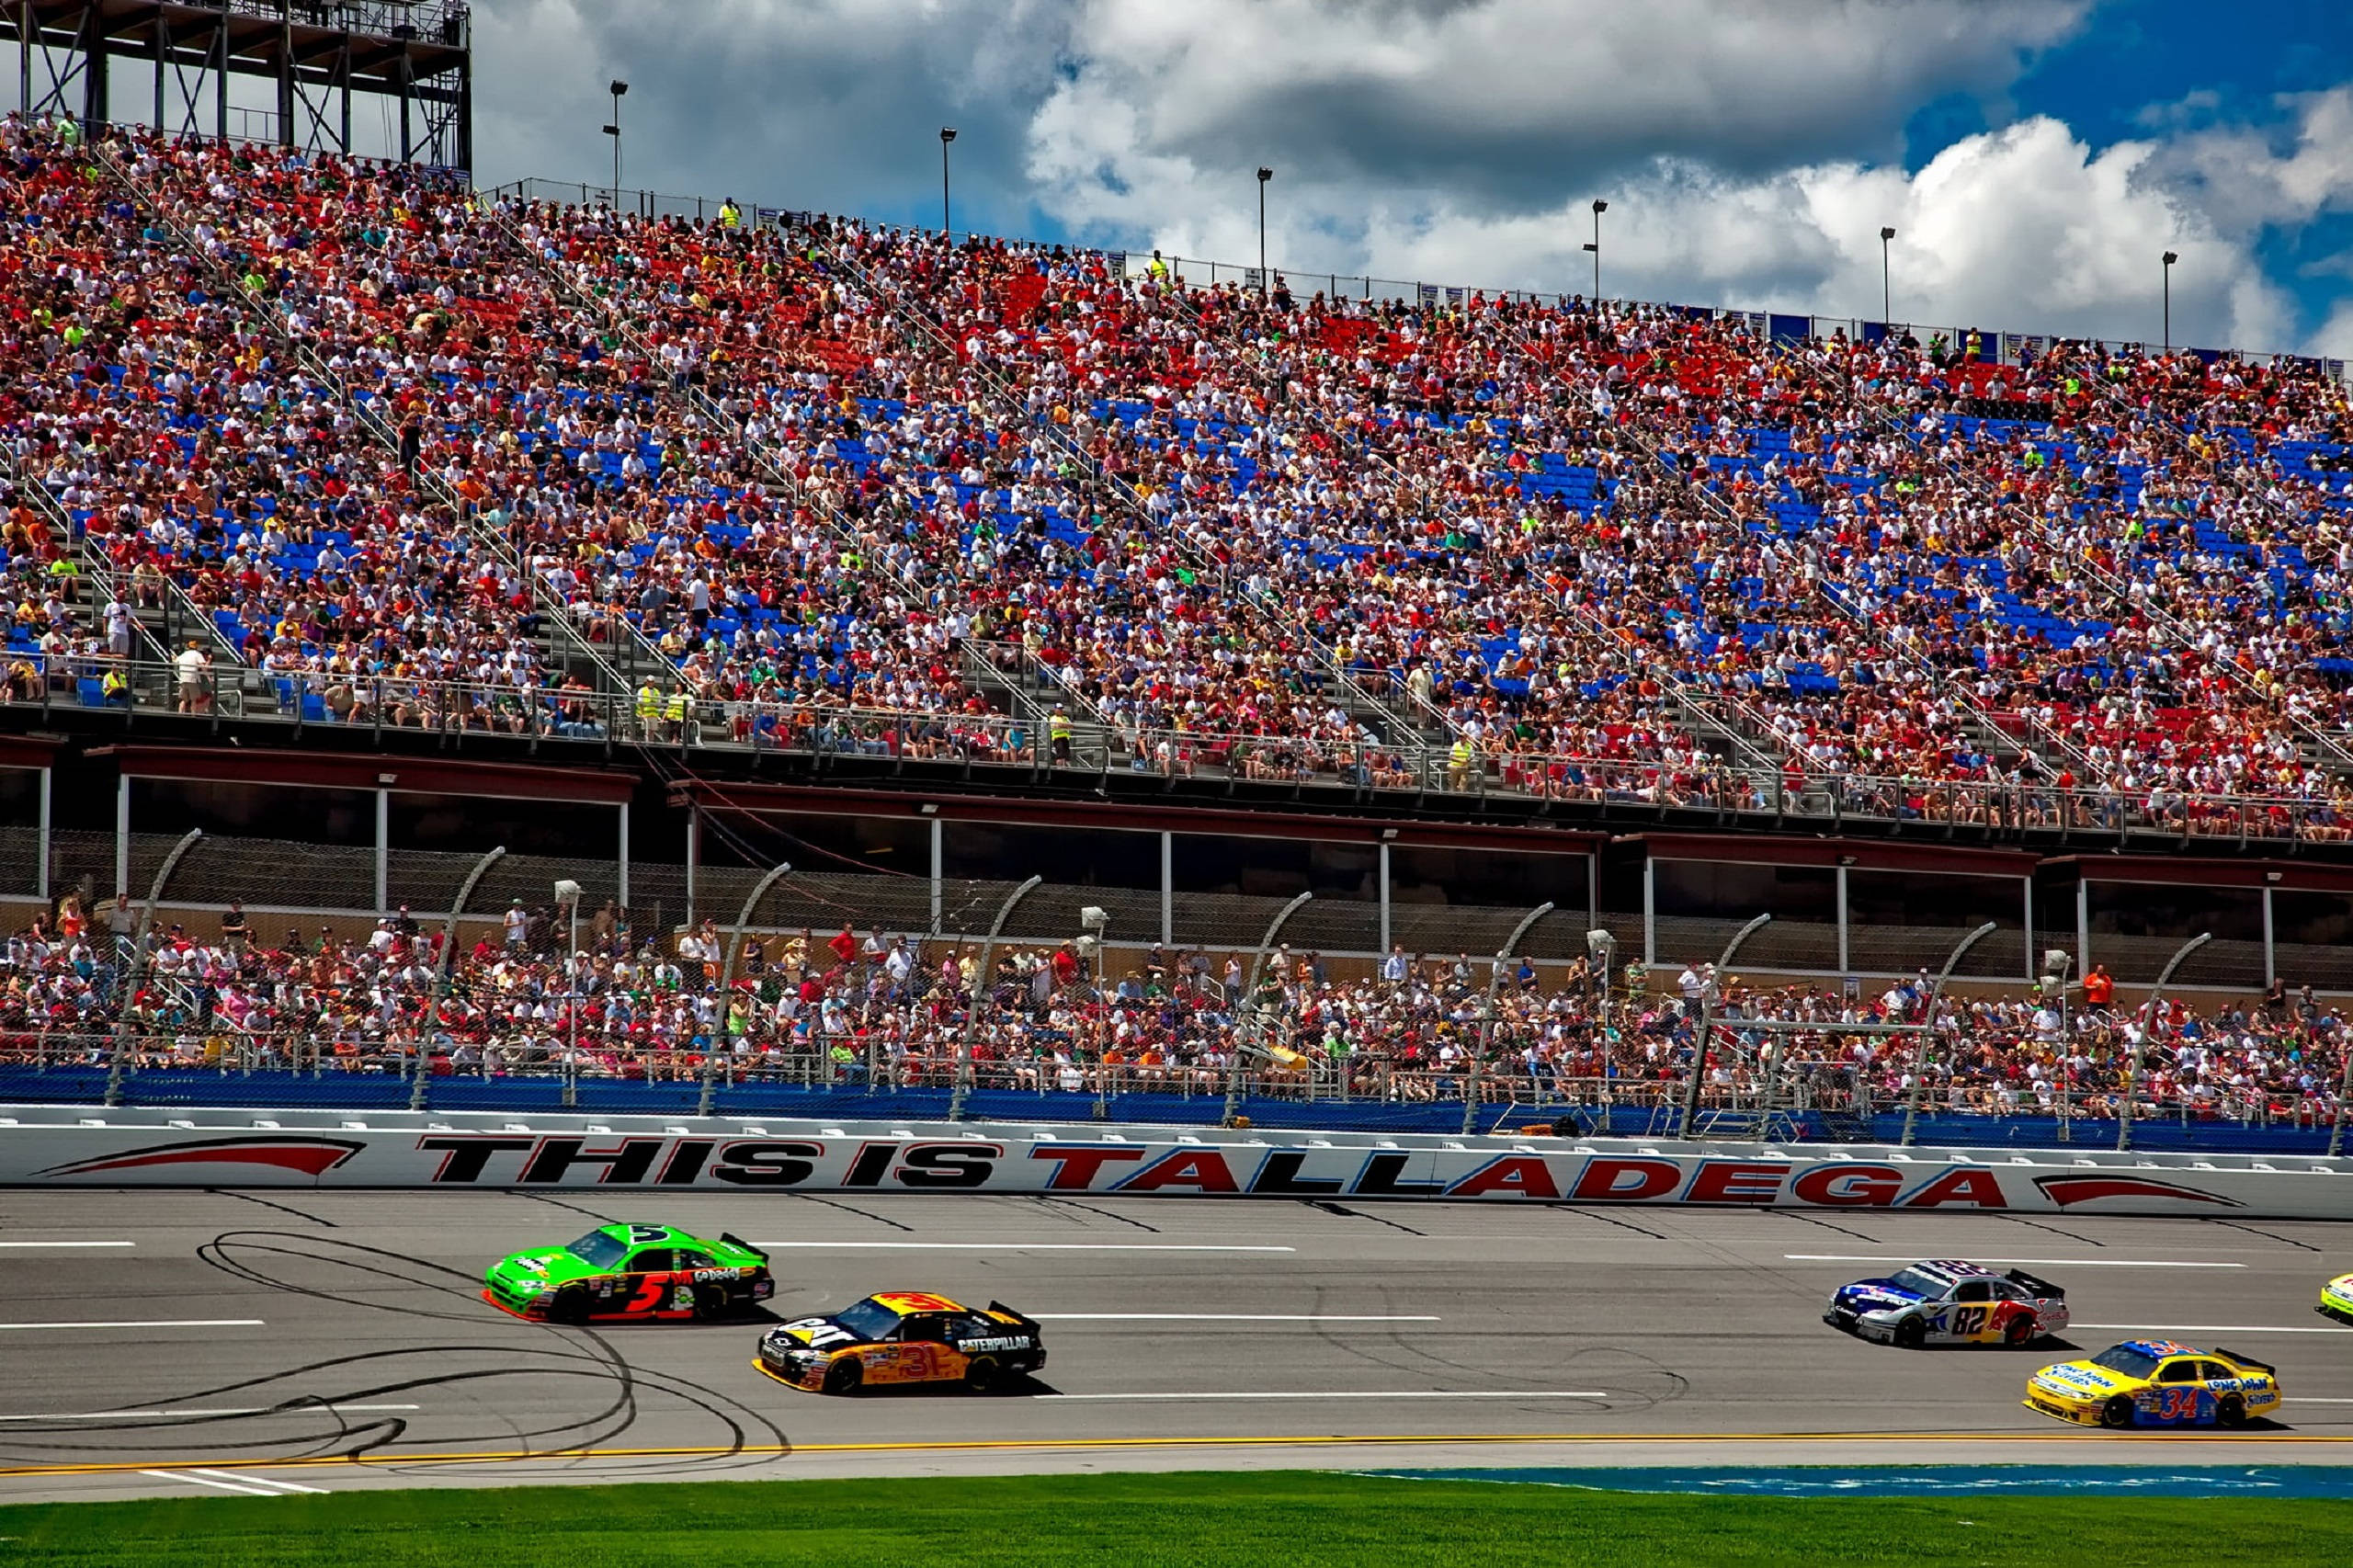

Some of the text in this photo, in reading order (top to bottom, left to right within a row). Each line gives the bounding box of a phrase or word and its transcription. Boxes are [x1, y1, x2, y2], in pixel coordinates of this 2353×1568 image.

[415, 1134, 2008, 1209] THIS IS TALLADEGA
[625, 1274, 670, 1312] 5
[779, 1318, 858, 1348] CAT
[1951, 1306, 1988, 1335] 82
[958, 1335, 1030, 1352] CATERPILLAR
[901, 1344, 940, 1379] 31
[2208, 1380, 2237, 1392] LONG
[2160, 1389, 2200, 1419] 34
